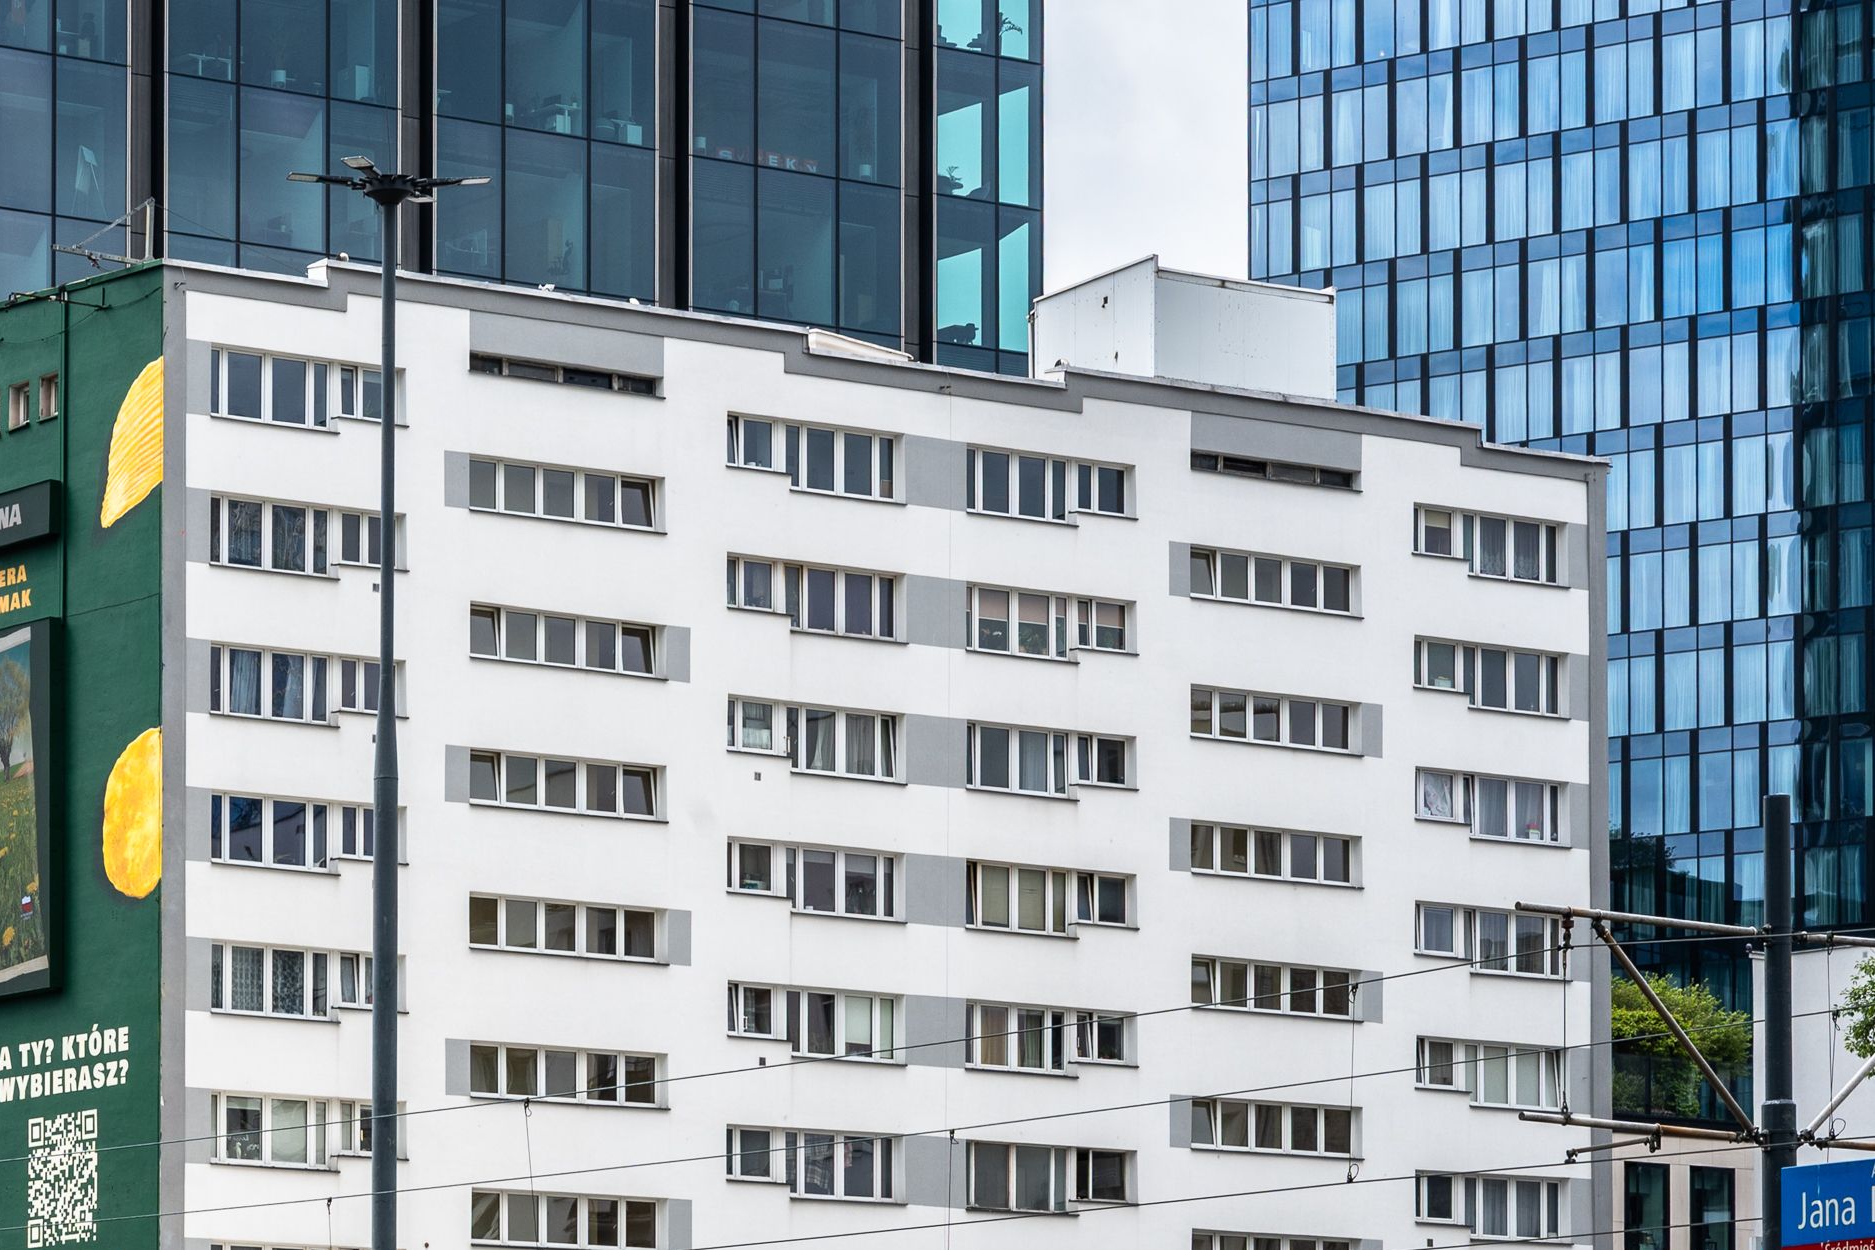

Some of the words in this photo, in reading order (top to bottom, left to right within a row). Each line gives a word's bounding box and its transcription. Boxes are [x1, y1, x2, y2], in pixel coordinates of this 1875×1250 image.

[19, 1038, 55, 1068] TY?
[62, 1023, 129, 1061] KTÓRE
[1797, 1191, 1856, 1230] Jana
